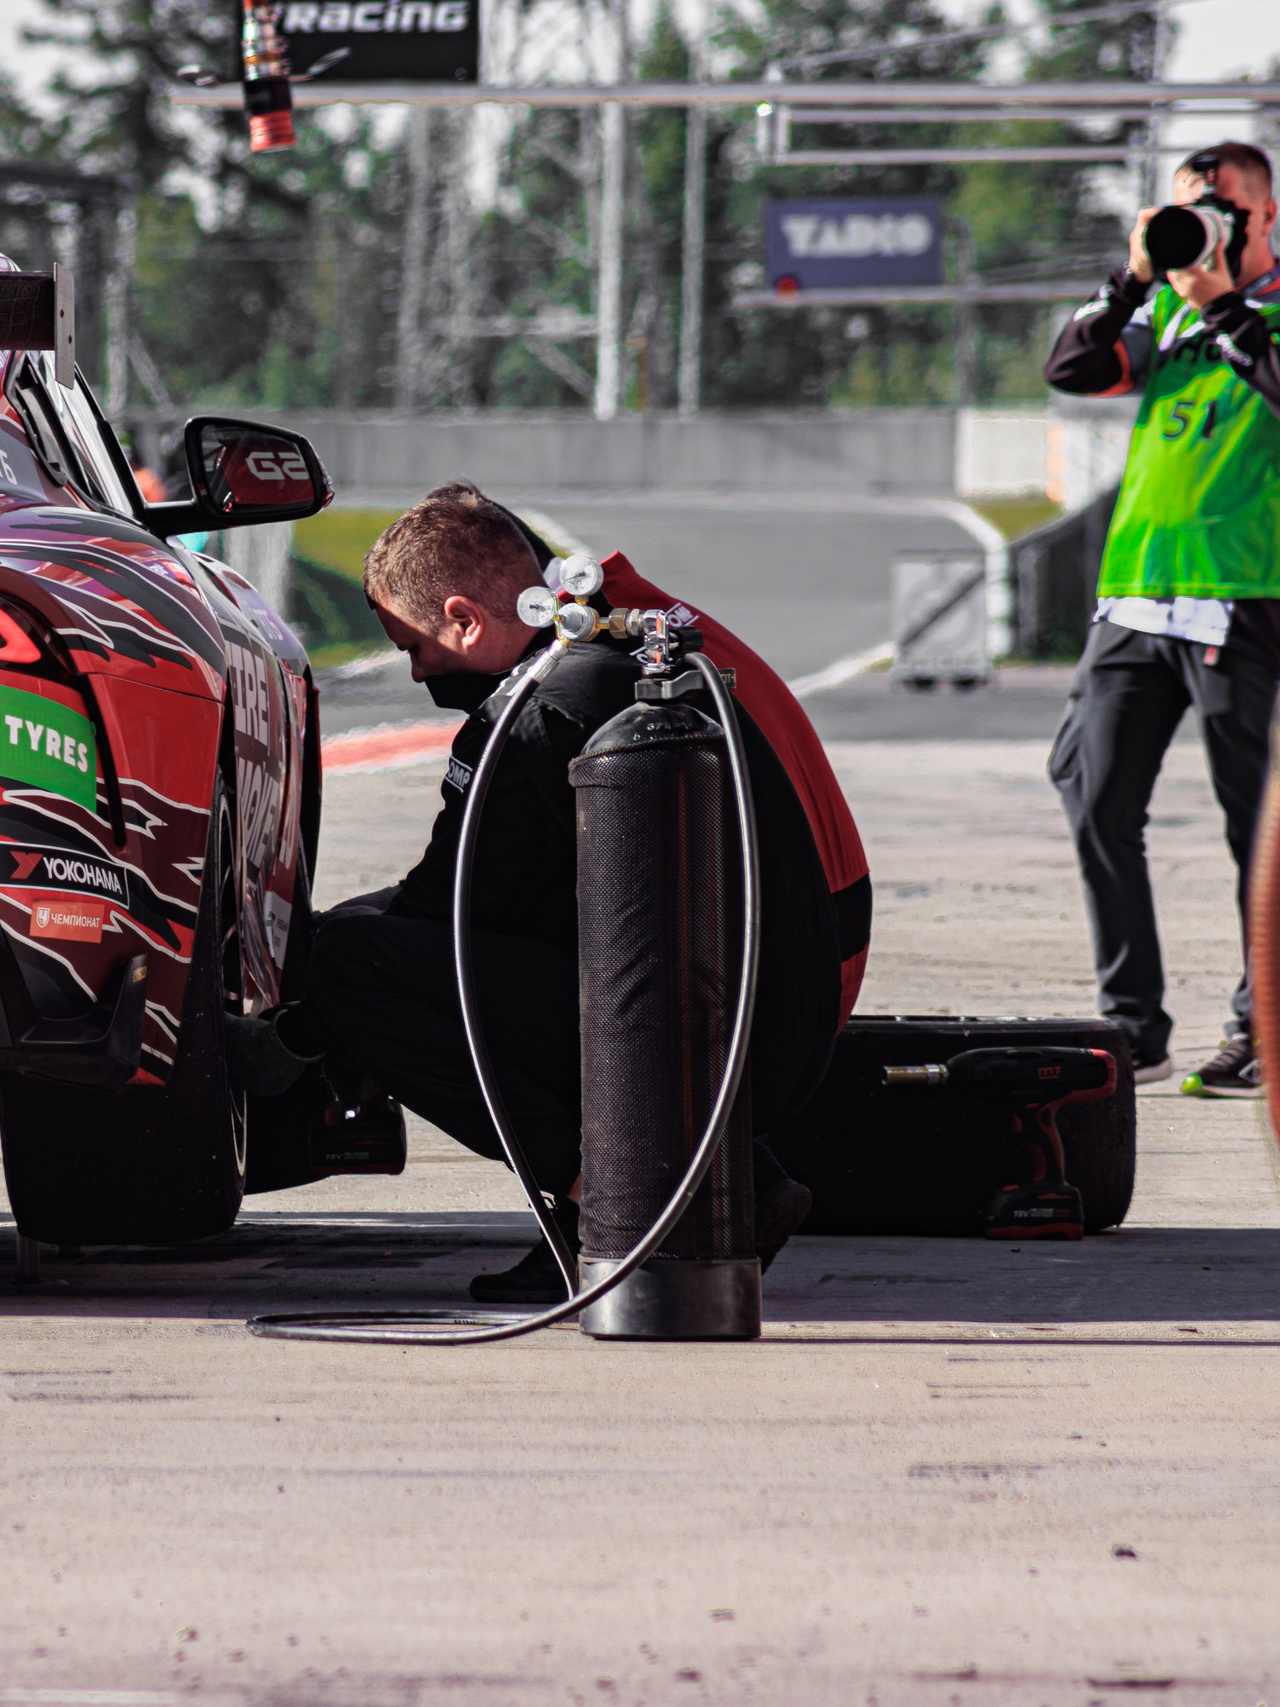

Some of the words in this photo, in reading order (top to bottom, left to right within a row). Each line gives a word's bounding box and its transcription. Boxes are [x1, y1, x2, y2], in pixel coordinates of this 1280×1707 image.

[1162, 401, 1217, 440] 51
[226, 638, 269, 747] IRE
[5, 715, 89, 773] TYRES
[448, 761, 471, 787] OMP
[43, 857, 122, 895] YOKOHAMA
[51, 914, 101, 928] ЧЕМПИОНАТ
